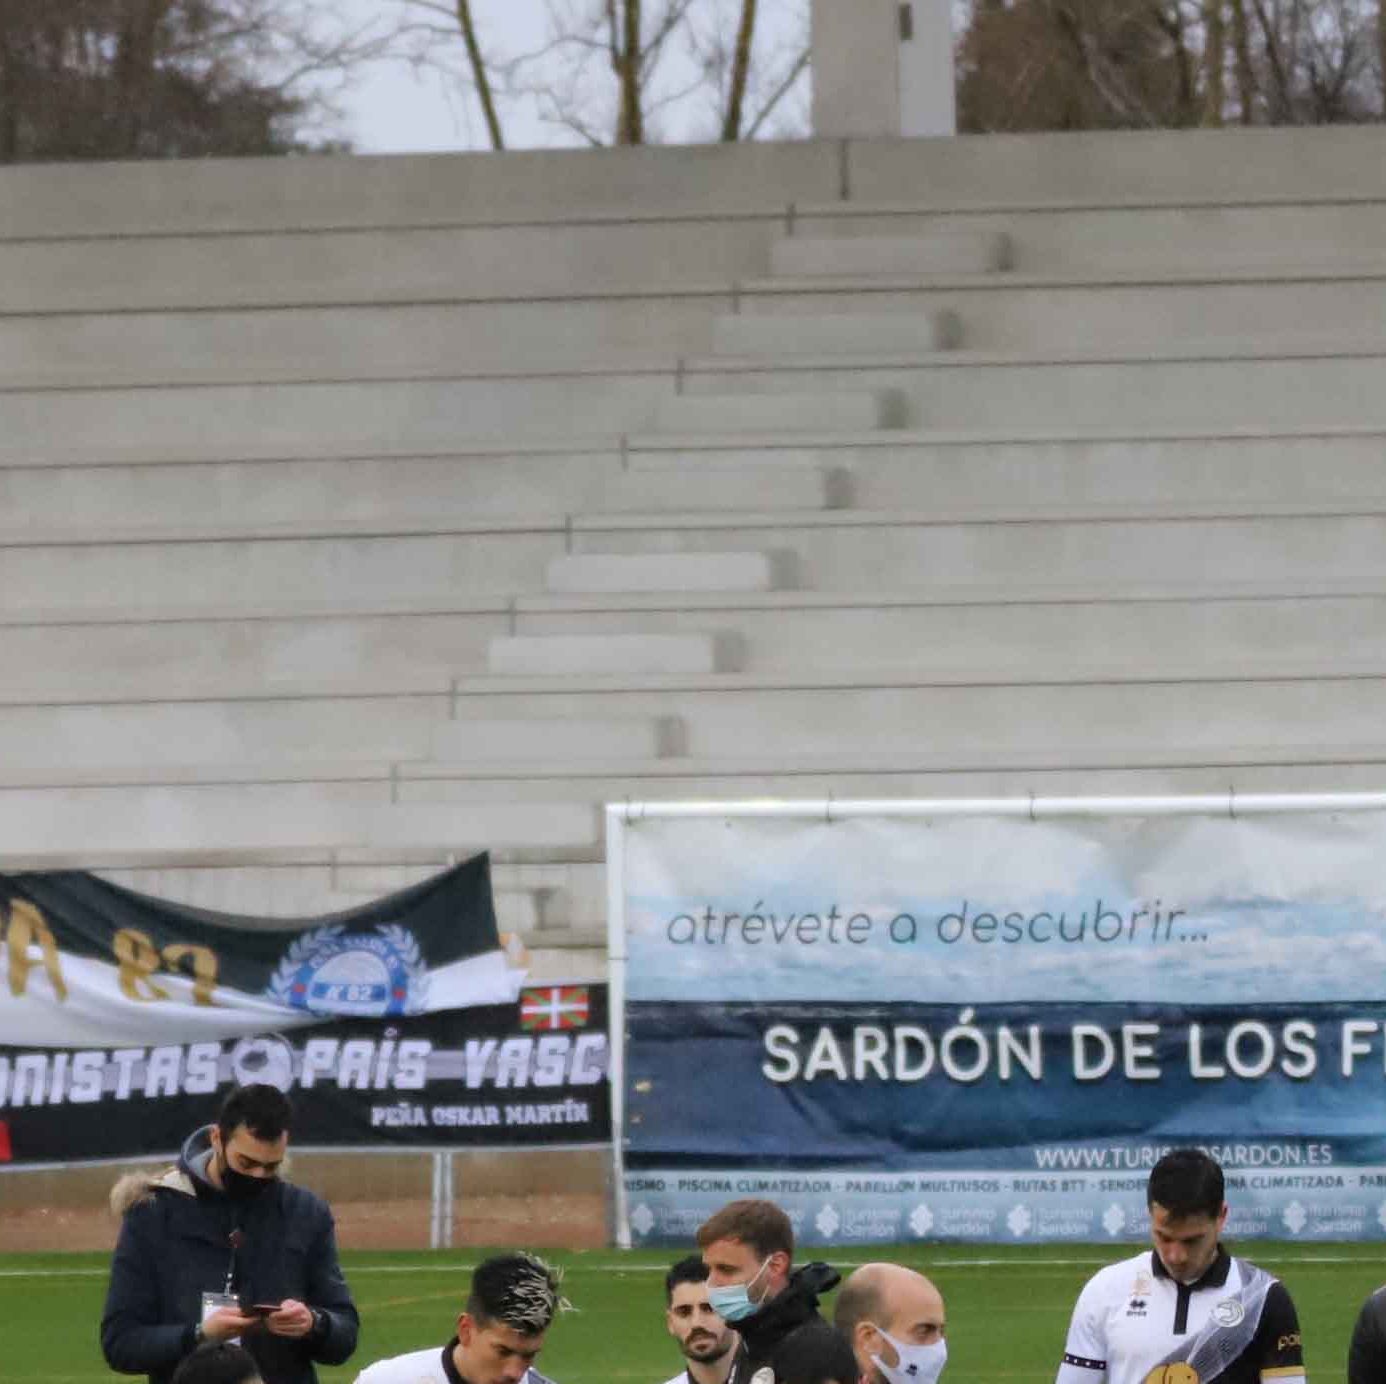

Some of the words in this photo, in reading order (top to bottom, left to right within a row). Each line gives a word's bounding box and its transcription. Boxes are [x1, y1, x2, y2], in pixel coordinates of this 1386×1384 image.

[666, 902, 872, 946] atrévete
[889, 914, 917, 944] a
[936, 900, 1209, 944] descubrir...
[301, 1028, 432, 1089] PAÍS
[465, 1033, 609, 1089] VASC
[761, 1009, 1041, 1082] SARDÓN
[1072, 1024, 1161, 1080] DE
[1188, 1021, 1318, 1078] LOS
[371, 1102, 428, 1127] PEÑA
[432, 1103, 501, 1126] OSKAR
[506, 1097, 589, 1125] MARTÍN
[1034, 1143, 1334, 1170] WWW.TURISOSARDON.ES
